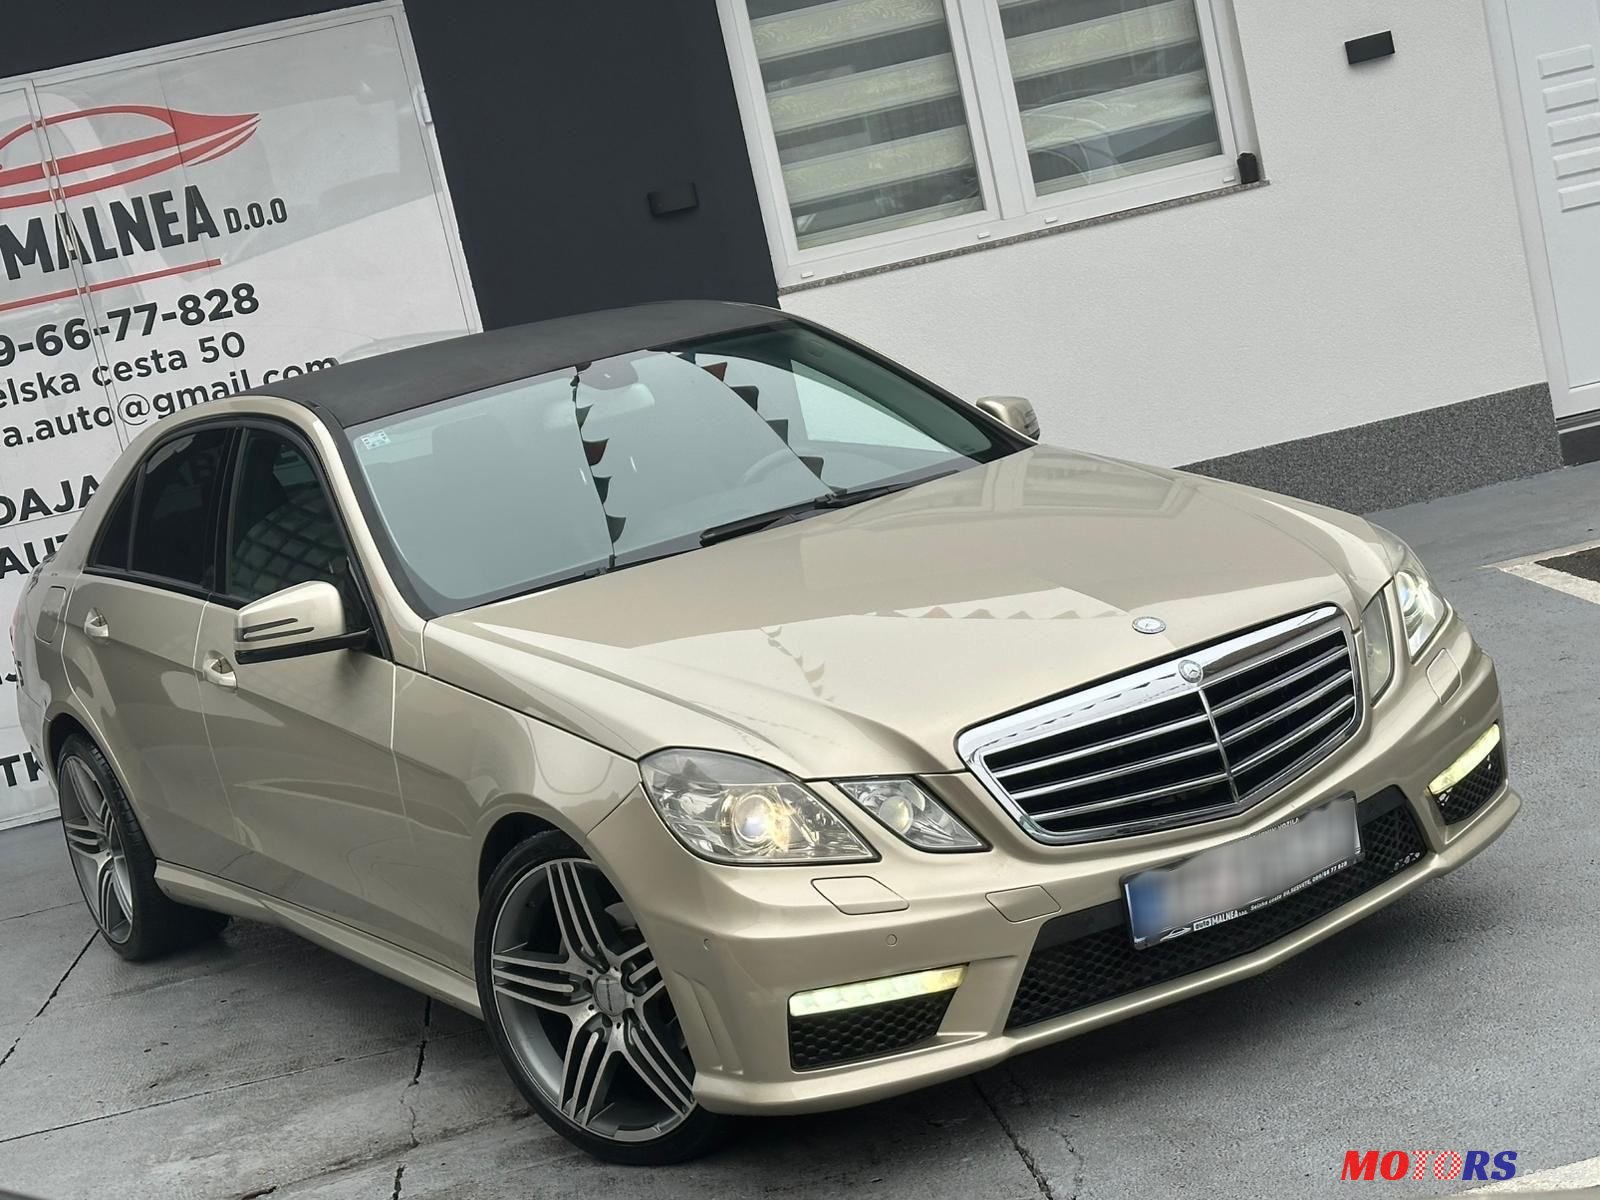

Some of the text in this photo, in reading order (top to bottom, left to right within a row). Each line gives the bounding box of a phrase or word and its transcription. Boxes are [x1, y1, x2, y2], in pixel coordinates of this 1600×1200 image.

[0, 184, 288, 280] MALNEA D.O.O
[92, 349, 188, 387] cesta
[198, 331, 245, 363] 50
[1211, 909, 1238, 925] MALNEA
